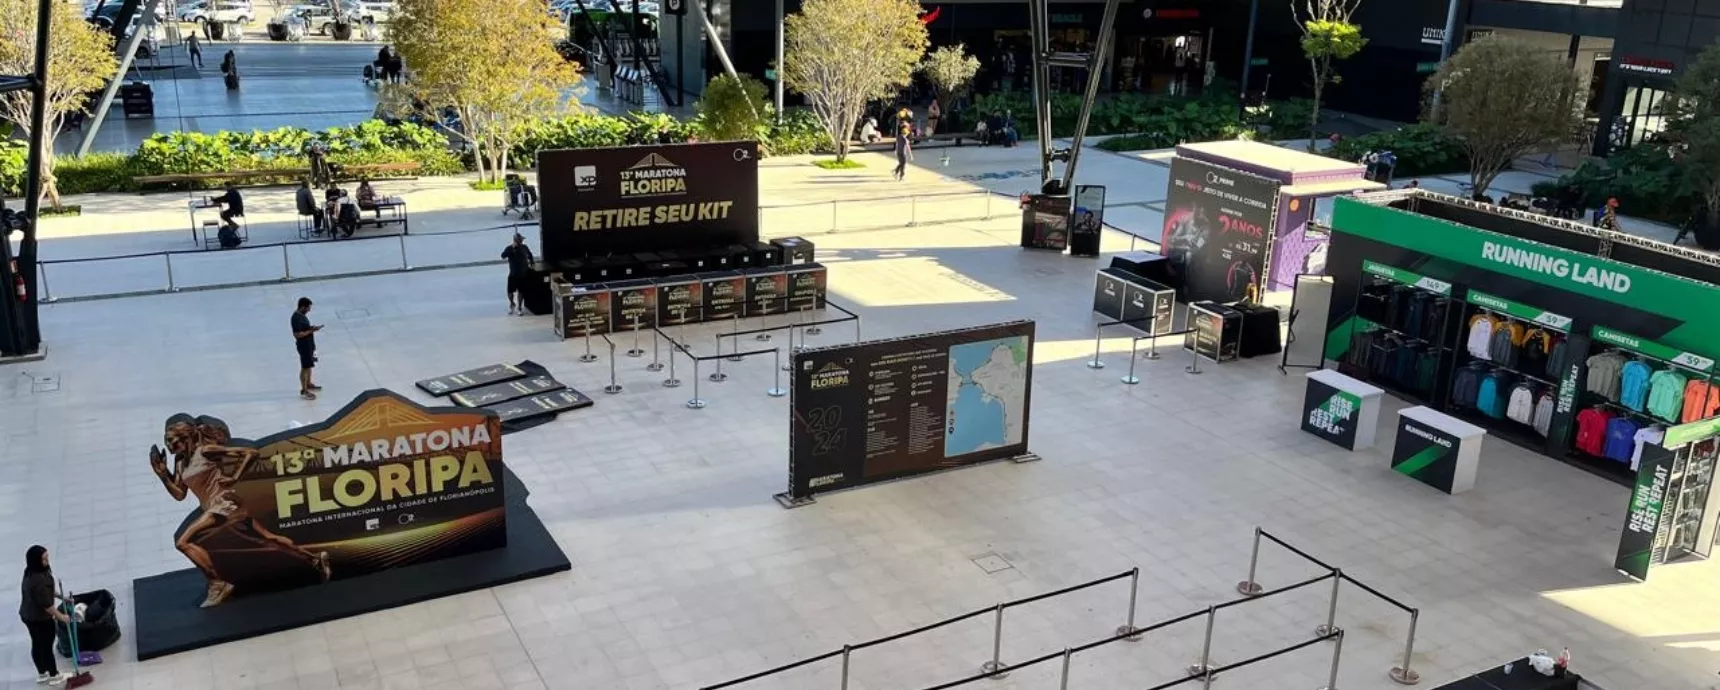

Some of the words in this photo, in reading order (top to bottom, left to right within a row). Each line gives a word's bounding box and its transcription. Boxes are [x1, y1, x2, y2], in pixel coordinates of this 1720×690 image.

[635, 168, 687, 179] MARATONA
[620, 177, 687, 195] FLORIPA
[573, 206, 651, 231] RETIRE
[654, 203, 695, 224] SEU
[698, 200, 734, 220] KIT
[1231, 218, 1264, 239] ANOS
[1481, 241, 1570, 278] RUNNING
[1571, 263, 1631, 294] LAND
[1472, 293, 1508, 310] CAMISETAS
[1598, 329, 1640, 347] CAMISETAS
[811, 376, 849, 389] FLORIPA
[1329, 403, 1350, 421] RUN
[1330, 394, 1353, 411] RISE
[1310, 407, 1336, 423] REST
[322, 423, 492, 469] MARATONA
[274, 450, 494, 519] FLORIPA
[1649, 464, 1669, 505] REPEAT
[1635, 484, 1651, 508] RUN
[279, 517, 323, 529] MARATONA
[324, 506, 385, 521] INTERNACIONAL
[399, 499, 427, 509] CIDADE
[428, 496, 438, 504] DE
[440, 487, 496, 501] FLORIANÓPOLIS
[1628, 508, 1645, 533] RISE
[1641, 506, 1659, 533] REST
